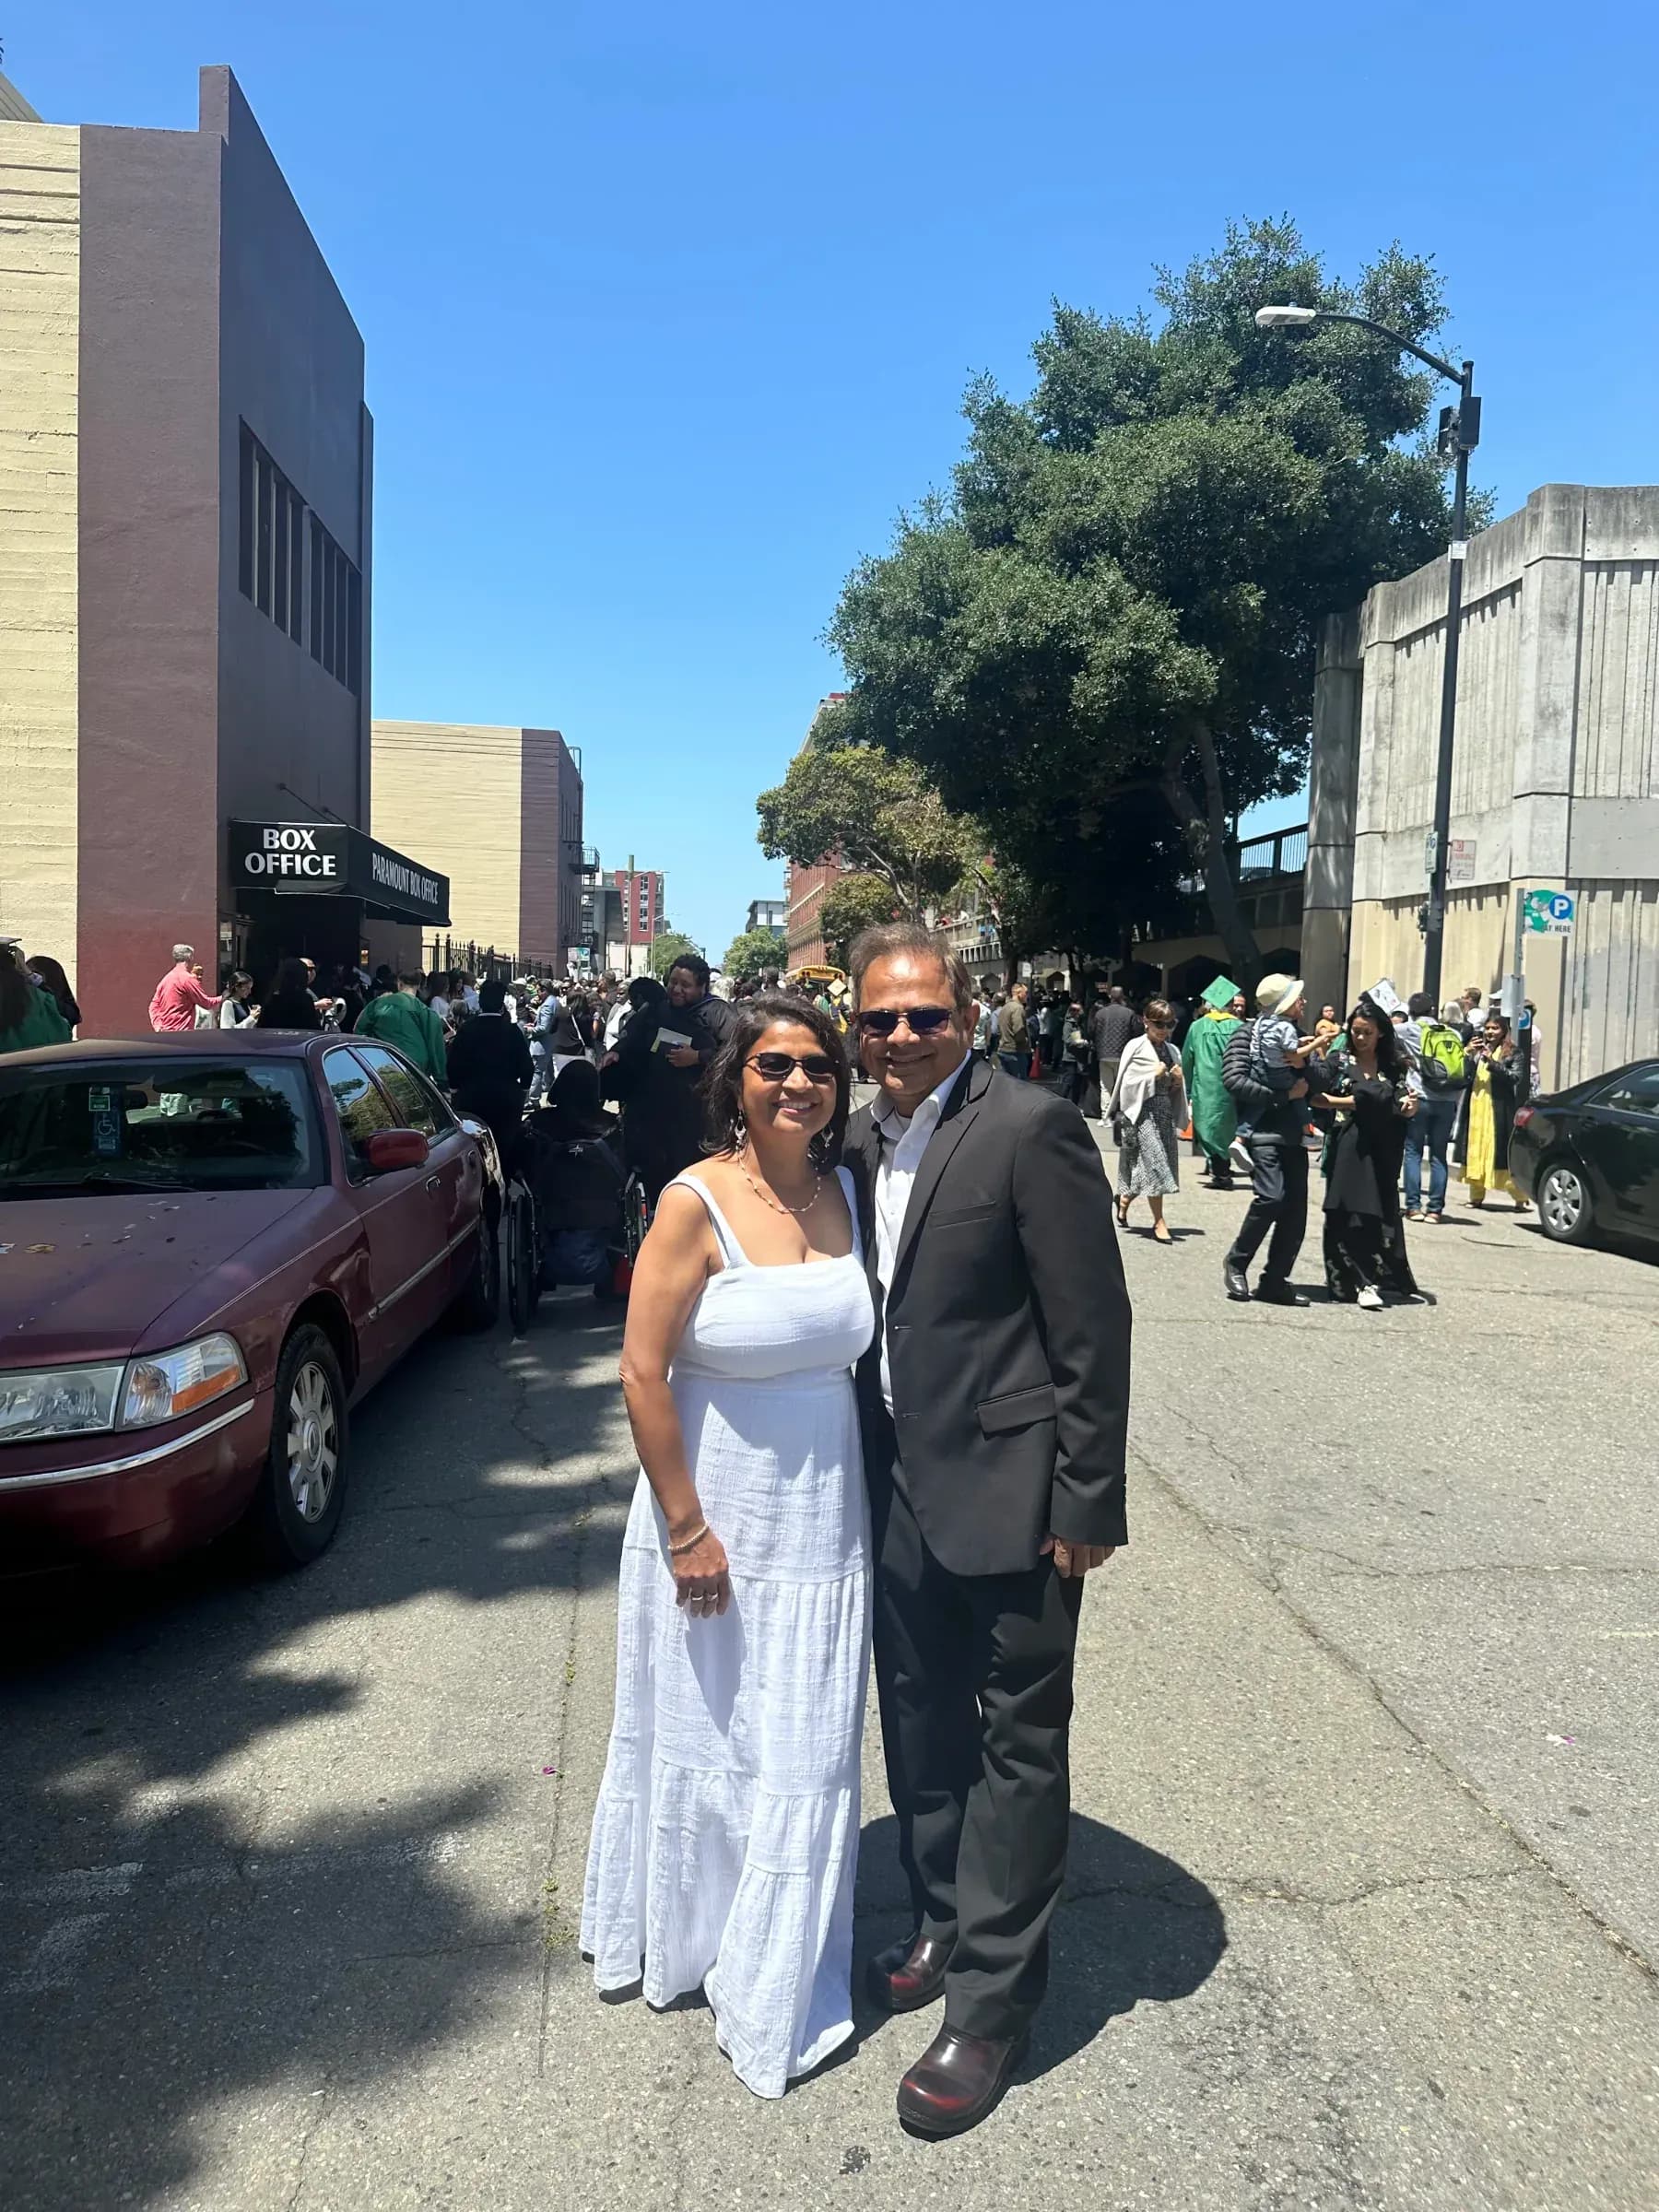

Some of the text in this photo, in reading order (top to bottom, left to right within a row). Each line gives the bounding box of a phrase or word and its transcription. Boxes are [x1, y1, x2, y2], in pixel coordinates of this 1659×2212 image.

[263, 829, 317, 850] BOX
[244, 853, 336, 876] OFFICE
[372, 853, 439, 904] PARAMOUNT BOX OFFICE
[1554, 899, 1569, 916] P
[1554, 924, 1571, 933] HERE
